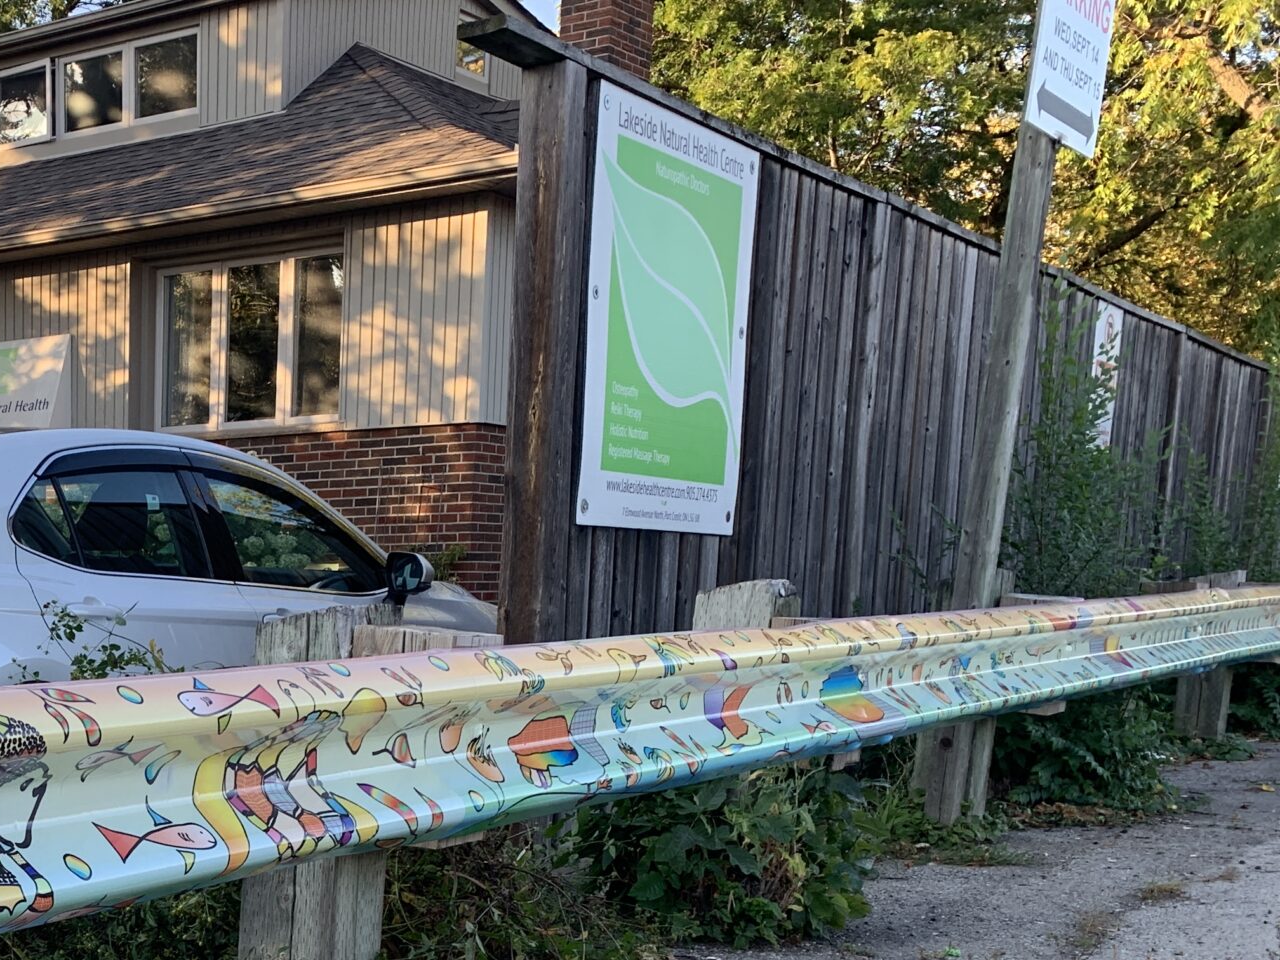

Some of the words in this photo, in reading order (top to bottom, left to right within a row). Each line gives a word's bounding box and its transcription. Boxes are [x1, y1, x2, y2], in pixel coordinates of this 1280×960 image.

[1065, 0, 1111, 33] KING
[1042, 47, 1058, 72] AND
[1091, 45, 1099, 65] 14
[618, 102, 657, 142] Lakeside
[660, 120, 690, 157] Natural
[693, 134, 719, 171] Health
[720, 148, 744, 180] Centre
[690, 175, 710, 196] Doctors
[14, 398, 49, 412] Health
